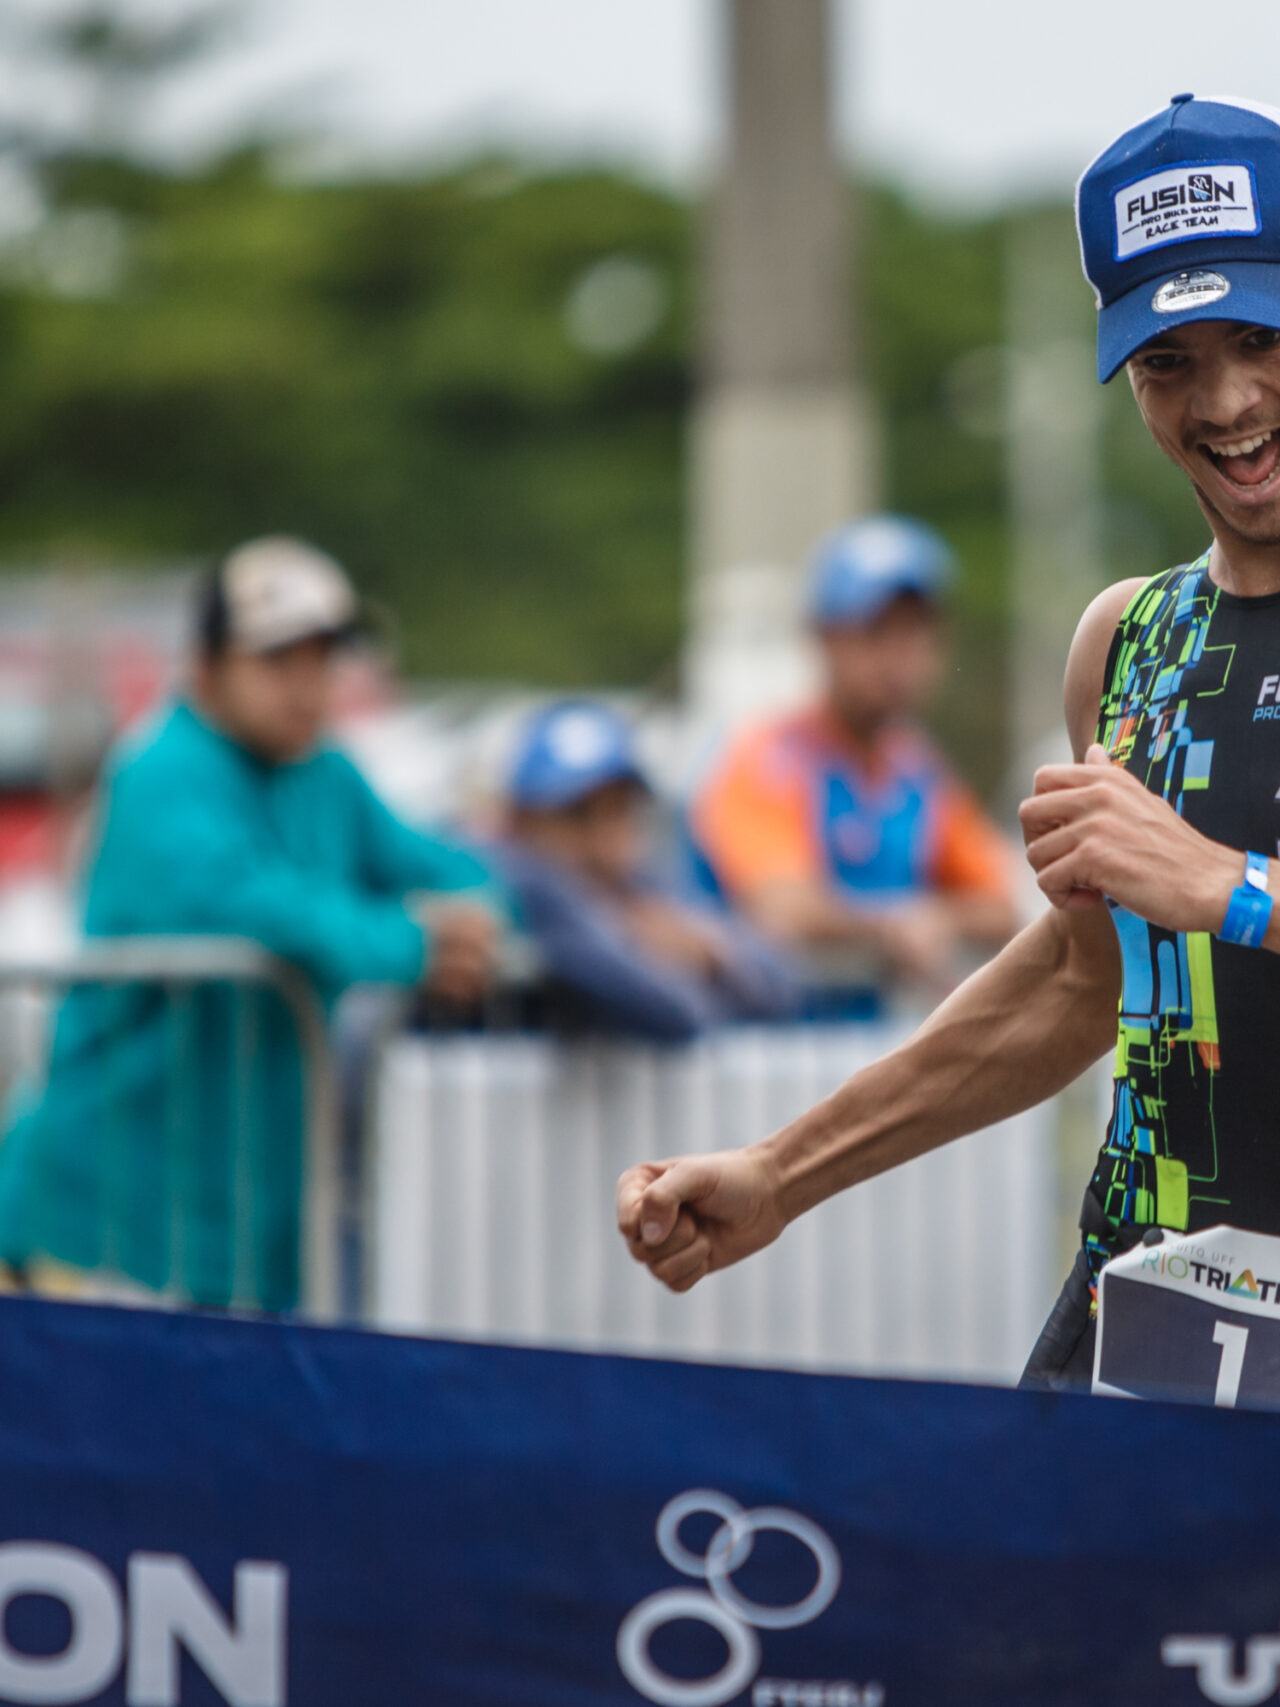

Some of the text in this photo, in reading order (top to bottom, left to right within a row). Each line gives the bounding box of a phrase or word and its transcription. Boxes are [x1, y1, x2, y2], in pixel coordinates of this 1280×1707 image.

[1127, 174, 1235, 222] FUSION
[1140, 204, 1222, 227] PRO BIKE SHOP
[1146, 215, 1218, 239] RACE TEAM
[1212, 1319, 1249, 1408] 1
